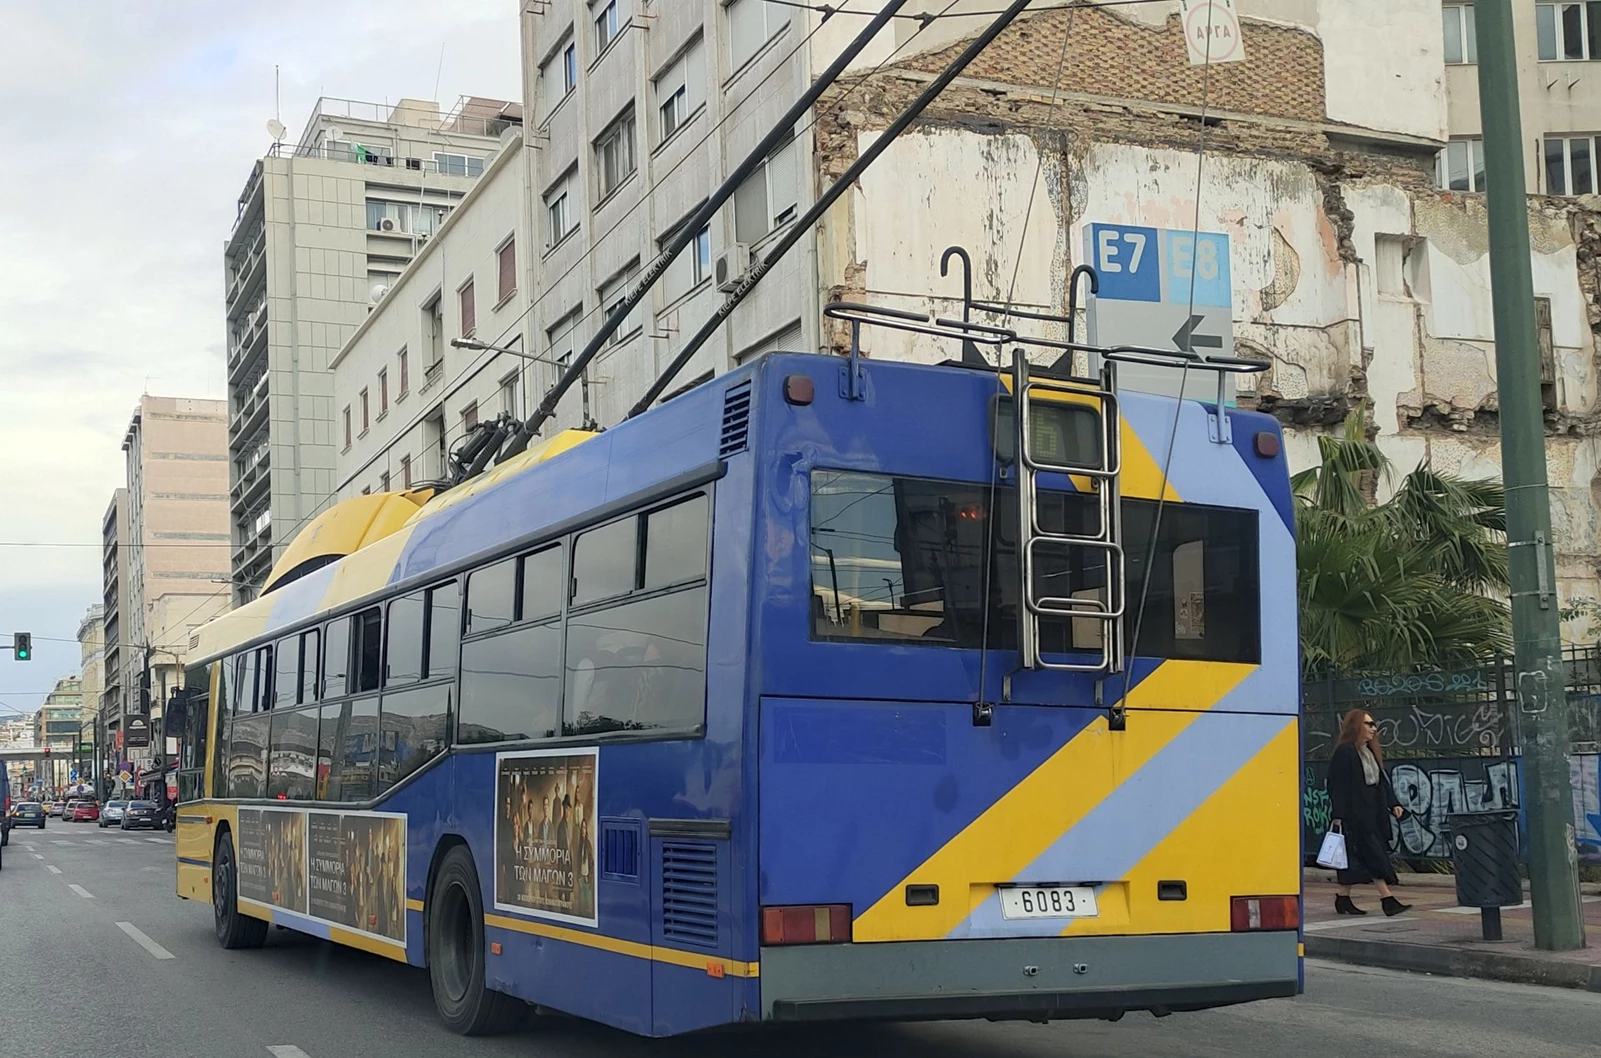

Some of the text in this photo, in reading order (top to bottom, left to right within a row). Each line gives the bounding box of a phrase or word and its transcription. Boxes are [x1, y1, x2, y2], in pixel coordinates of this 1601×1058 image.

[1098, 229, 1146, 274] E7
[1172, 236, 1219, 280] E8
[624, 284, 643, 306] KIEPE
[717, 261, 768, 317] KIEPE ELEKTRIK
[515, 845, 571, 865] Η ΣΥΜΜΟΡΙΑ
[514, 865, 574, 888] ΤΩΝ ΜΑΓΩΝ 3
[1022, 890, 1075, 912] 6083
